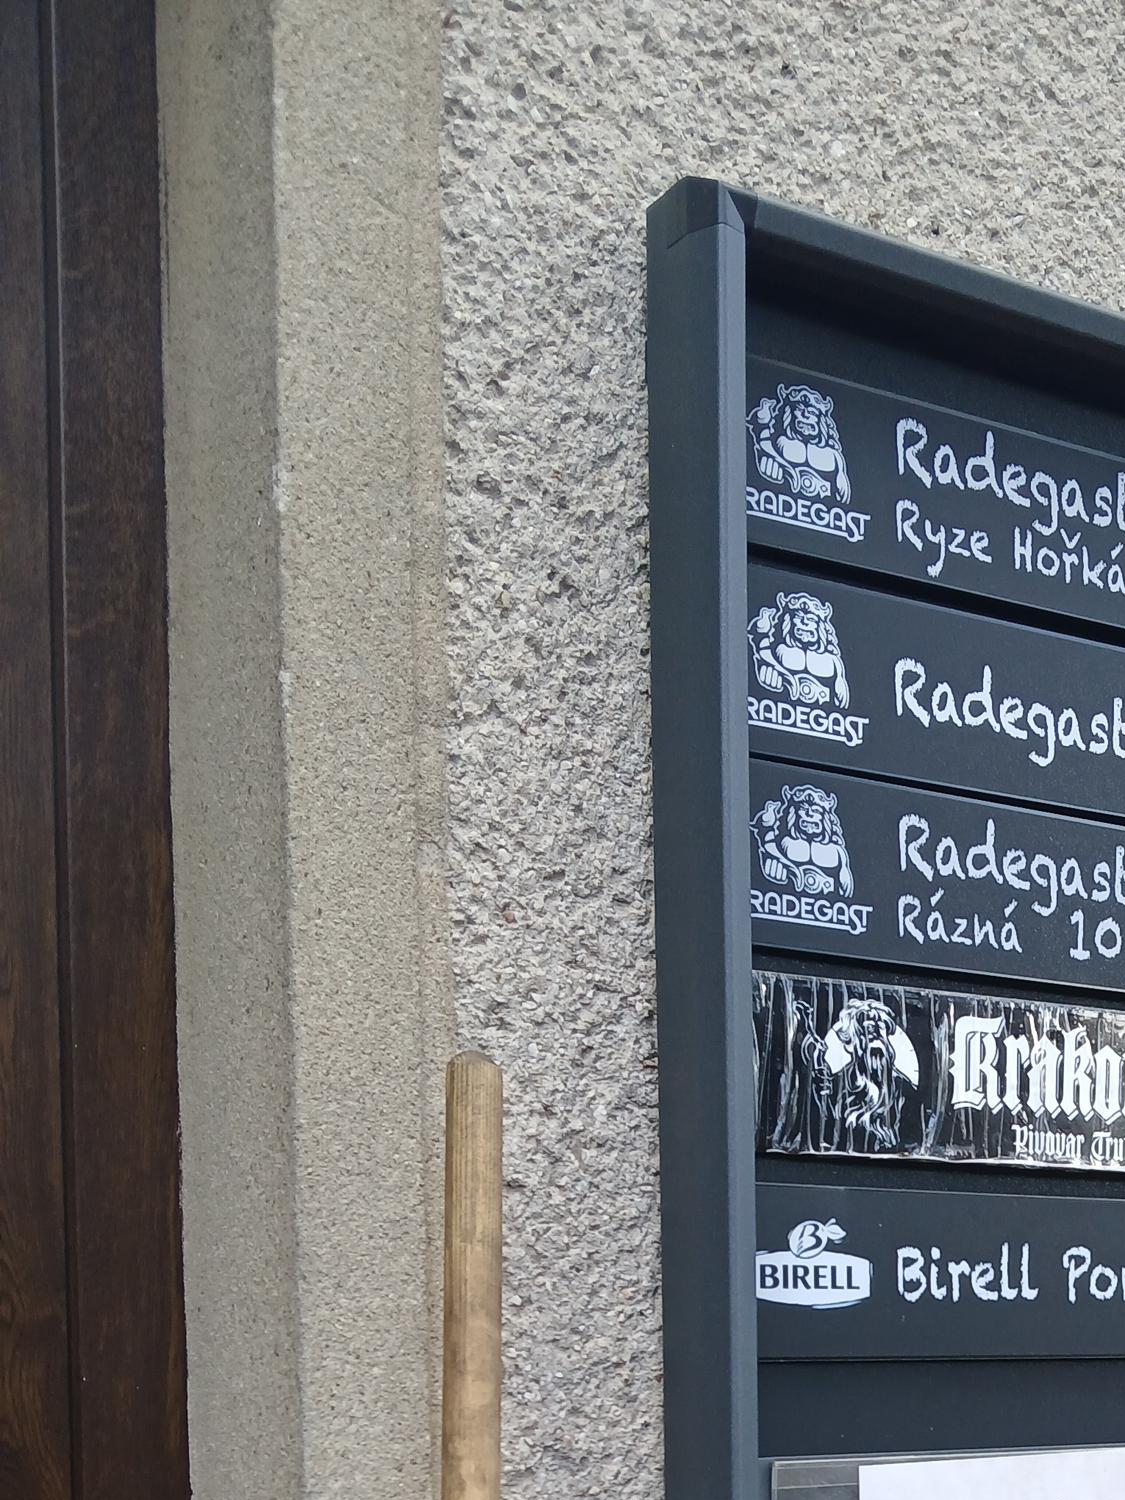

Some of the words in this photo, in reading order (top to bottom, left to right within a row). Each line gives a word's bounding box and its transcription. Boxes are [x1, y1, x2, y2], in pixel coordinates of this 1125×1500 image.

[895, 499, 992, 578] Ryze
[899, 888, 1022, 953] Rázná
[1070, 908, 1122, 961] 10
[1012, 1125, 1085, 1161] Pivovar
[760, 1263, 861, 1290] BIRELL
[896, 1242, 1038, 1303] Birell
